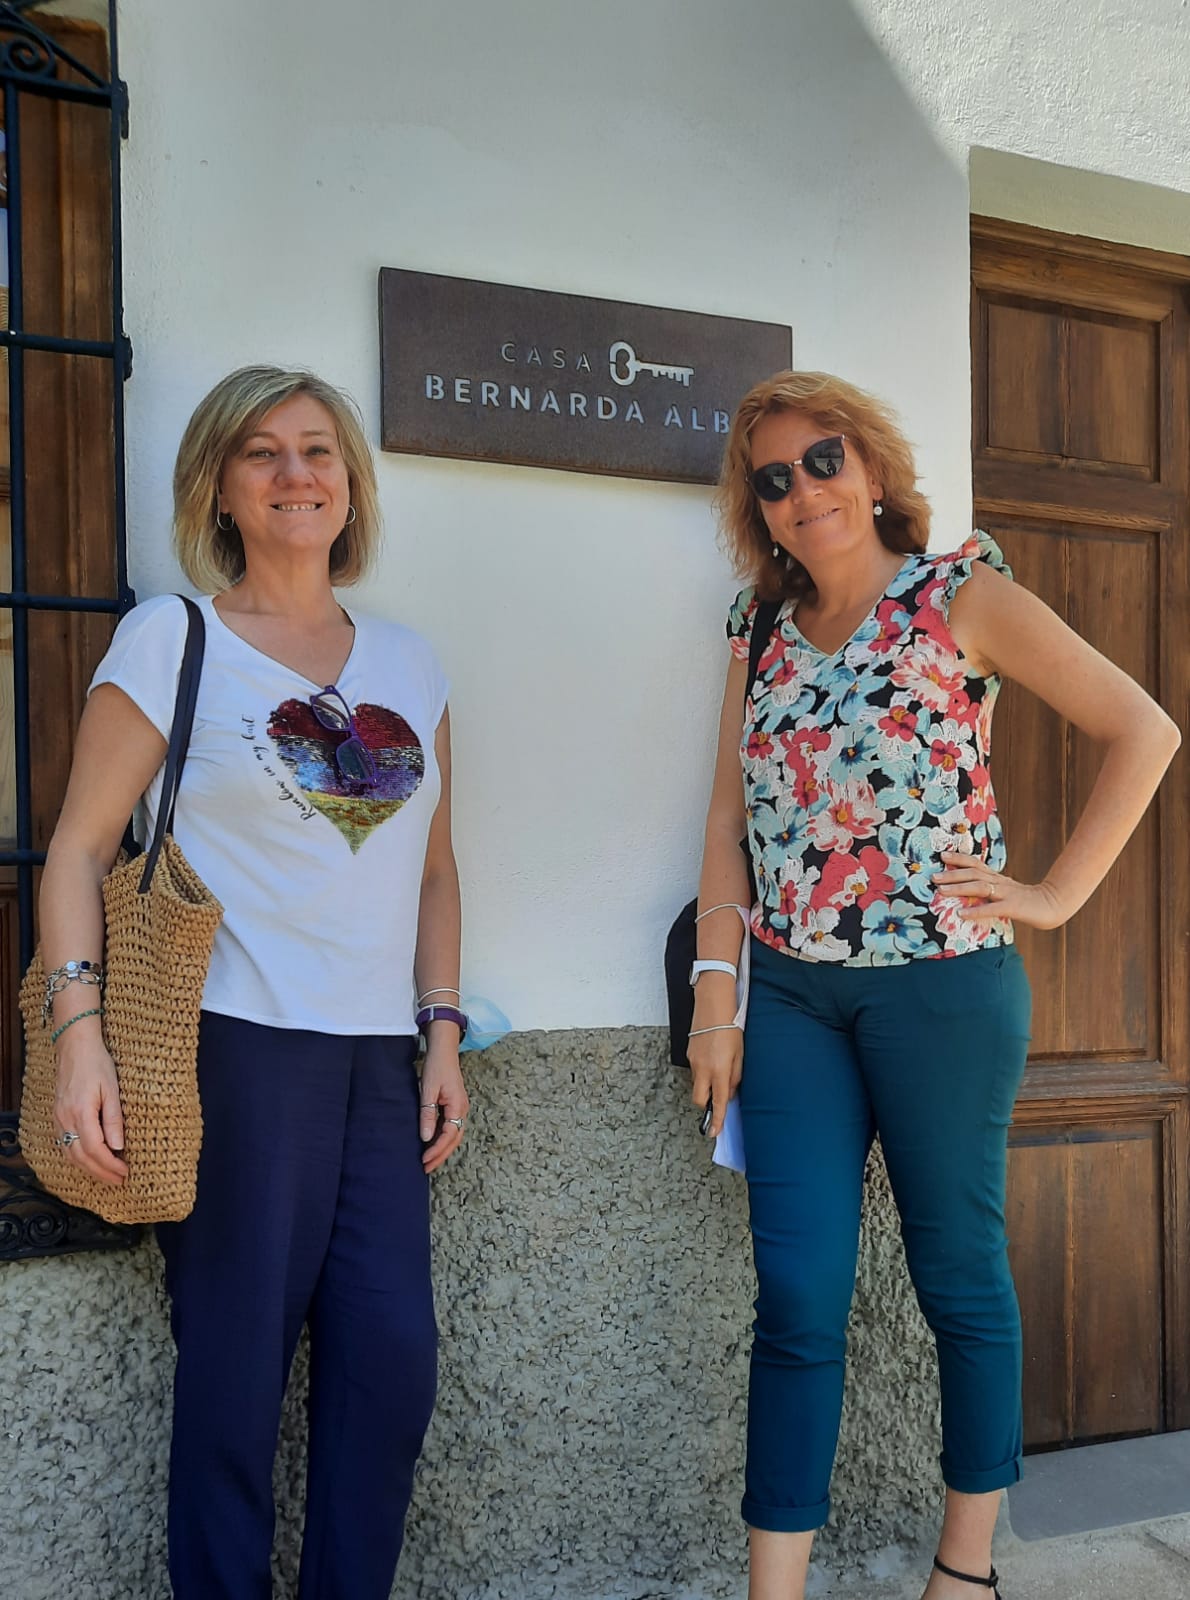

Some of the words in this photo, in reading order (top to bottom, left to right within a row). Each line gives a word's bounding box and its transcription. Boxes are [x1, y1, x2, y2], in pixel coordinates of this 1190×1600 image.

[500, 342, 592, 373] CASA
[425, 374, 646, 425] BERNARDA
[664, 404, 730, 434] ALB
[252, 745, 270, 761] my
